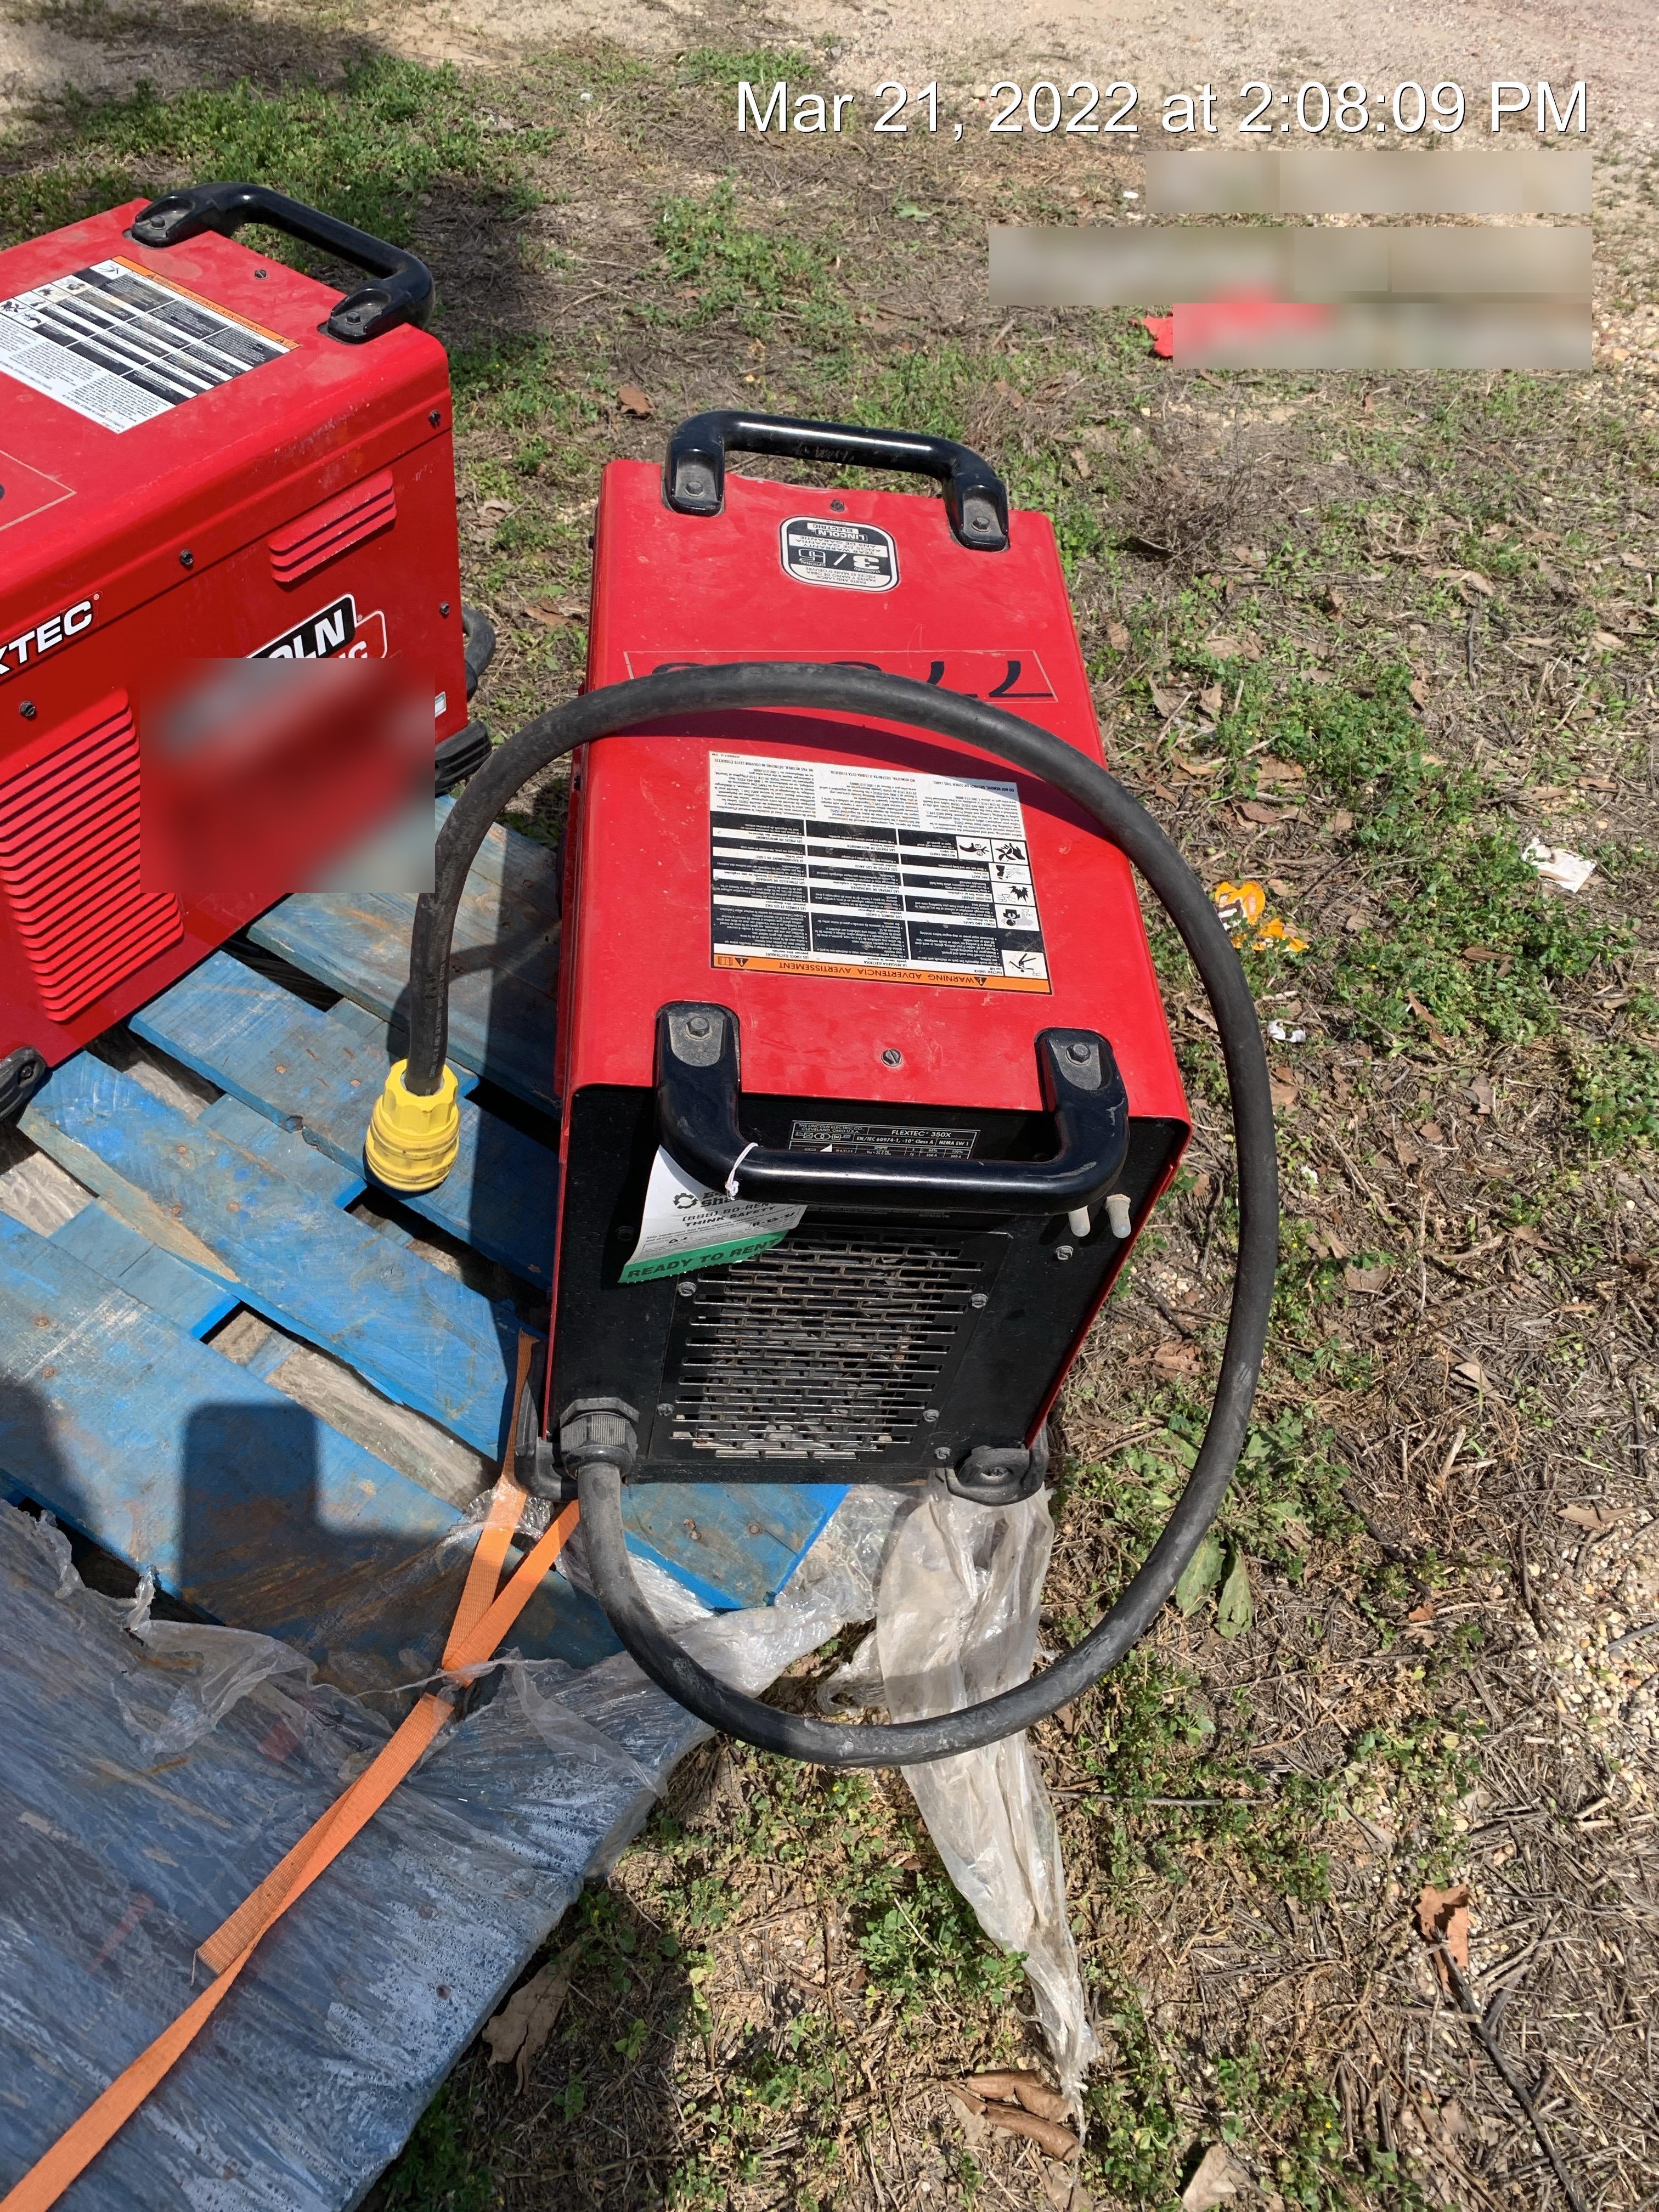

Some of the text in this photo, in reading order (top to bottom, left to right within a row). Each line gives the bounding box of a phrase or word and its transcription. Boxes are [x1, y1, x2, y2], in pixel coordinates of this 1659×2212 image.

[800, 537, 843, 545] GARANTIE
[818, 529, 865, 540] LINCOLN
[803, 544, 850, 552] WARRANTY
[798, 549, 826, 563] 5
[853, 555, 880, 569] 3
[777, 961, 974, 983] WARNING ADVERTENCIA AVERTISSEMENT
[682, 1210, 718, 1222] (888)
[723, 1202, 775, 1214] 80-REN
[685, 1215, 726, 1227] THINK
[730, 1205, 776, 1219] SAFETY
[628, 1238, 781, 1279] READY TO RENT
